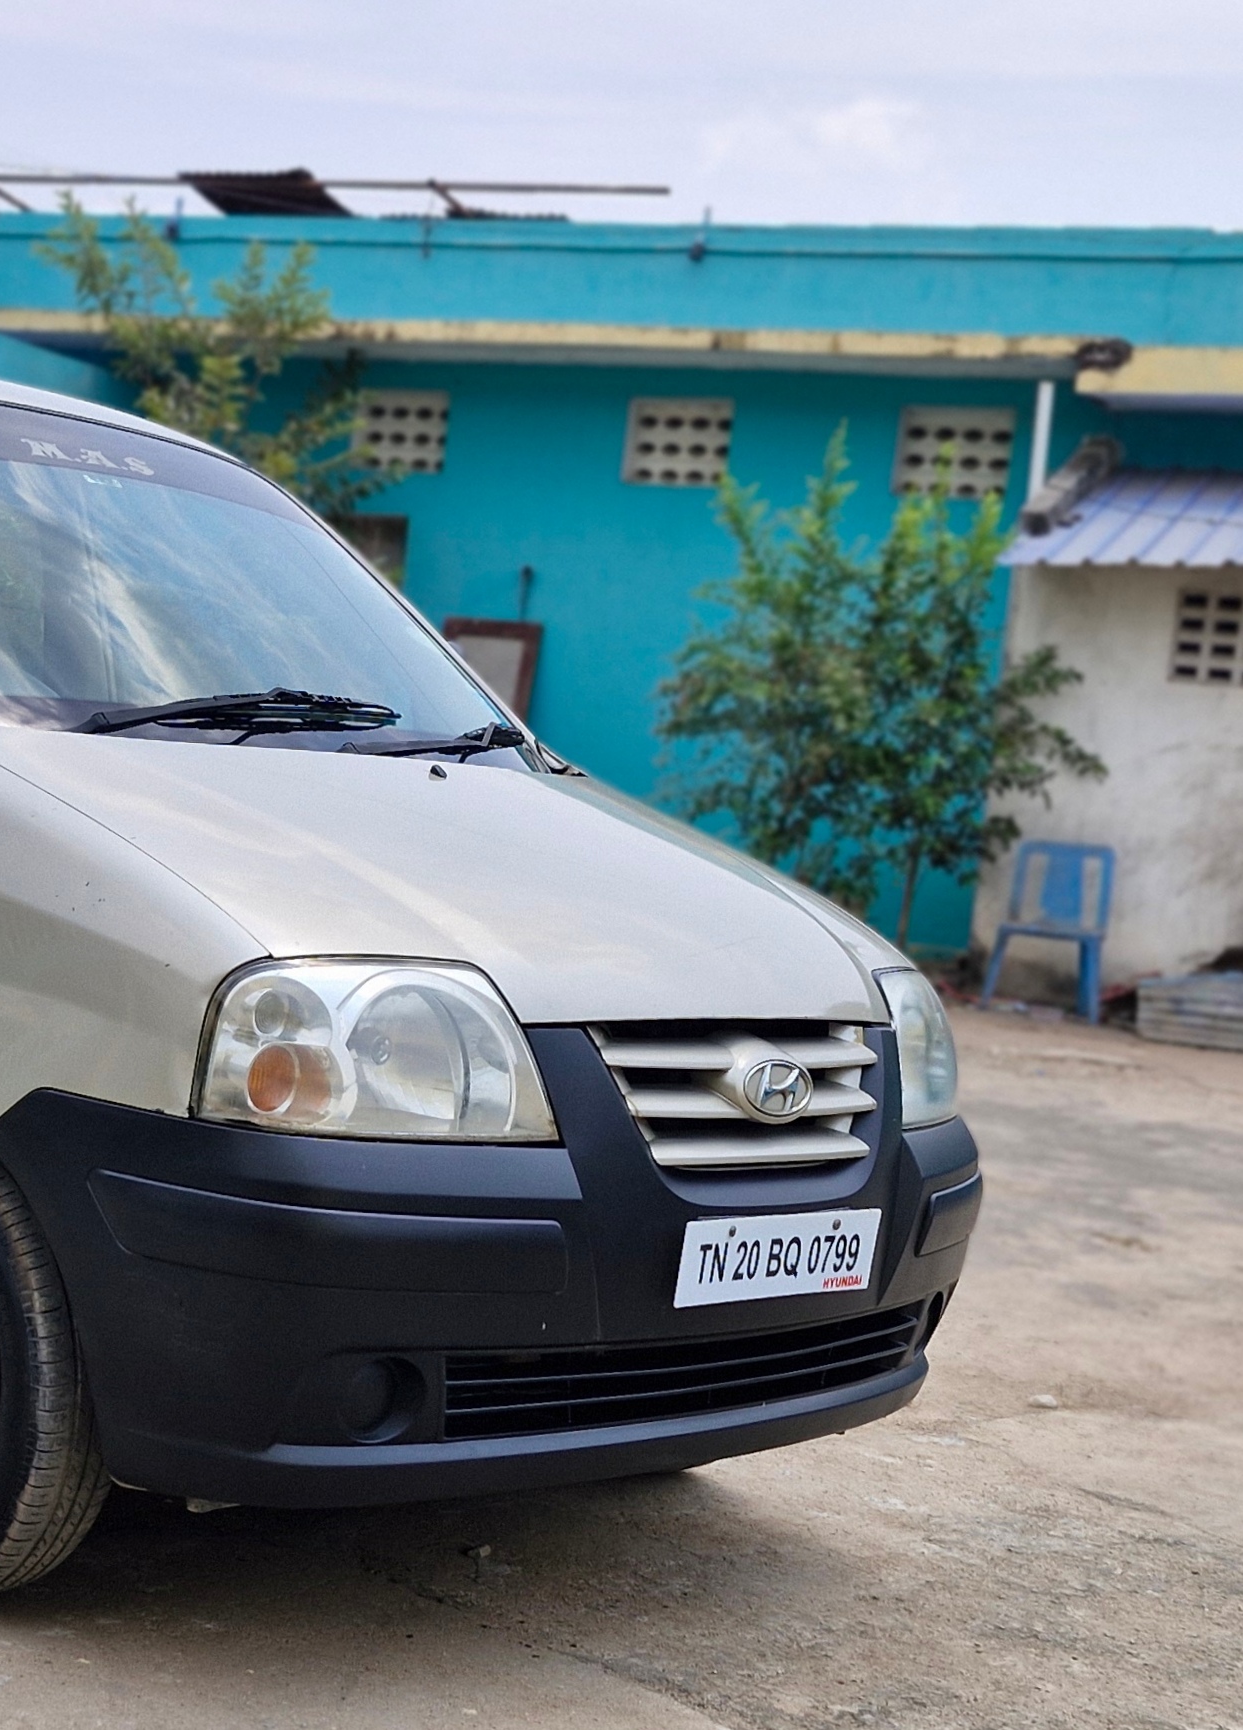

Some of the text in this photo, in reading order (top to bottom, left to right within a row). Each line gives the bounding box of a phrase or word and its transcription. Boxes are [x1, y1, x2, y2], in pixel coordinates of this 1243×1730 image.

[21, 438, 155, 476] M.A.S
[698, 1233, 860, 1284] TN 20 BQ 0799
